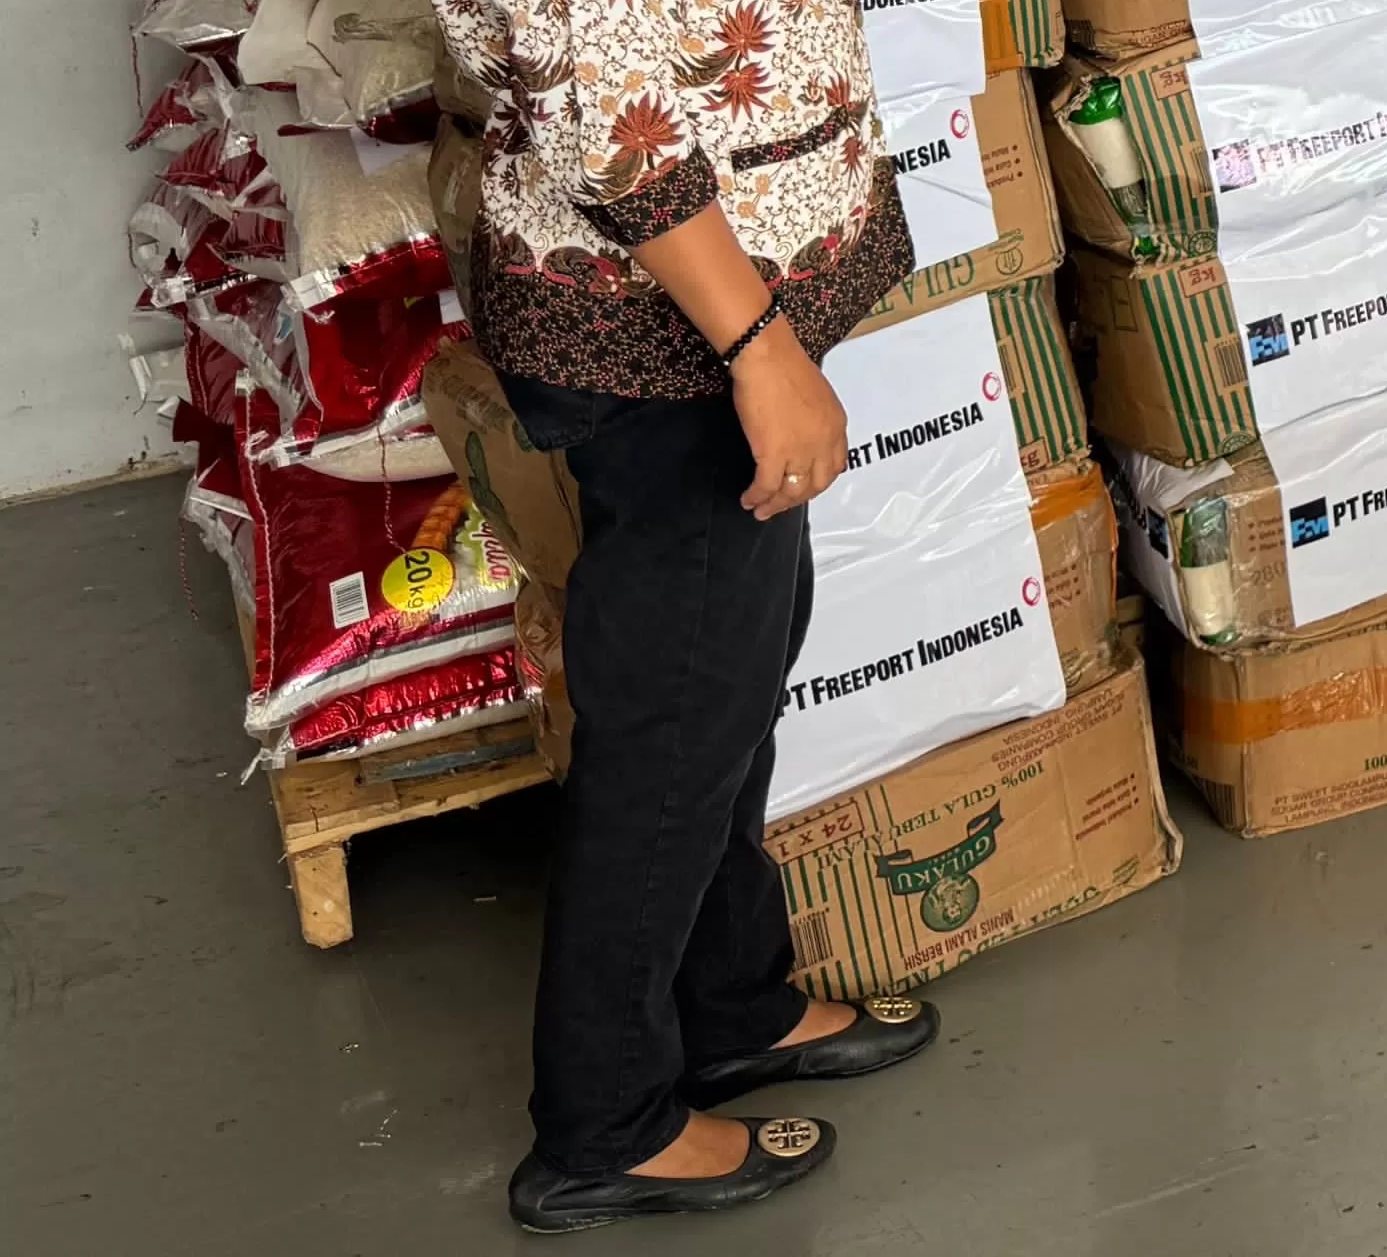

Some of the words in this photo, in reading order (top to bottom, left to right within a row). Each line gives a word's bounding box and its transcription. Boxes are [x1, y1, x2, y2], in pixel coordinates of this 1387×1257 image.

[1290, 316, 1321, 346] PT
[875, 402, 983, 458] INDONESIA
[1332, 497, 1360, 528] PT
[404, 550, 432, 583] 20
[810, 649, 913, 705] FREEPORT
[919, 607, 1022, 665] INDONESIA
[1001, 762, 1044, 788] 100%
[945, 782, 997, 812] GULA
[824, 811, 853, 833] 24
[890, 805, 941, 838] TEBU
[776, 842, 788, 857] 1
[896, 835, 990, 891] GULAKU
[981, 909, 1014, 934] MANIS
[944, 925, 978, 950] ALAMI
[903, 943, 942, 970] BERSIH
